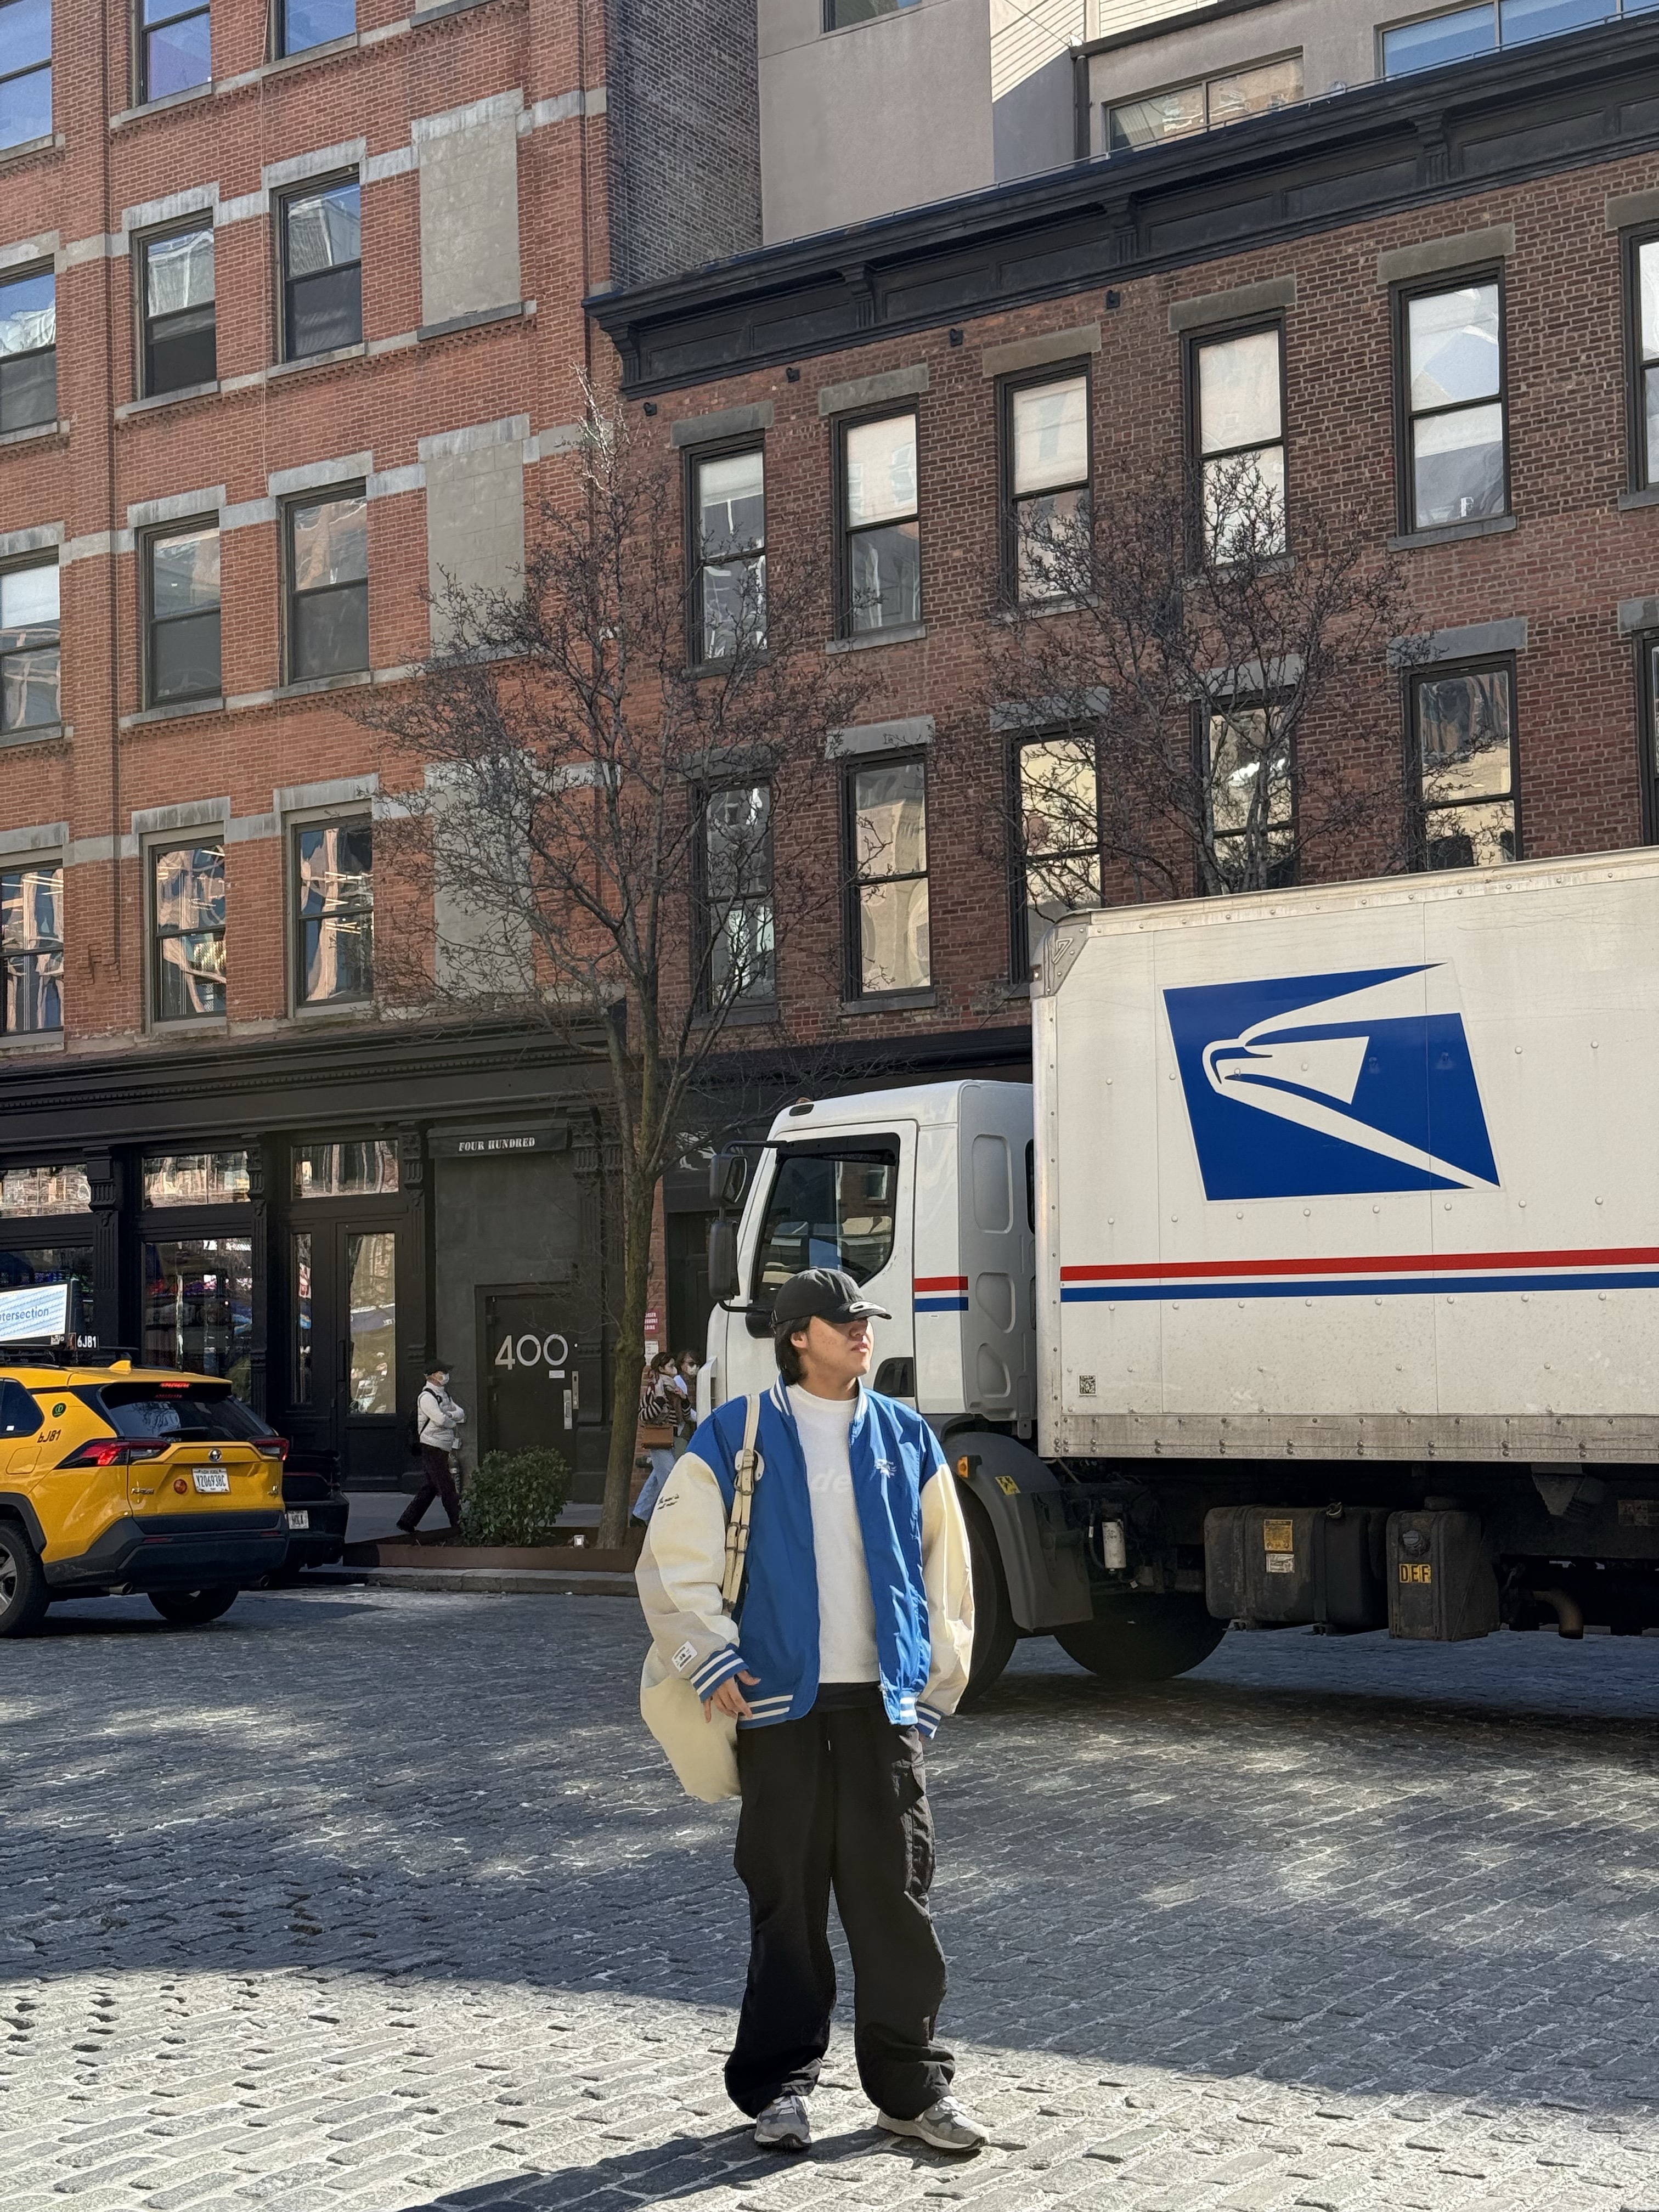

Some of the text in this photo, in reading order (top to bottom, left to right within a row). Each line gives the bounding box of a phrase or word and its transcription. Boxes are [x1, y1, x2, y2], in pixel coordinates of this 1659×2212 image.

[458, 1137, 535, 1152] FOUR HUNDRED
[0, 1306, 49, 1322] tersection
[77, 1335, 97, 1348] 6J81
[495, 1334, 568, 1370] 400
[37, 1429, 61, 1443] 6J81
[1401, 1565, 1429, 1582] DEF
